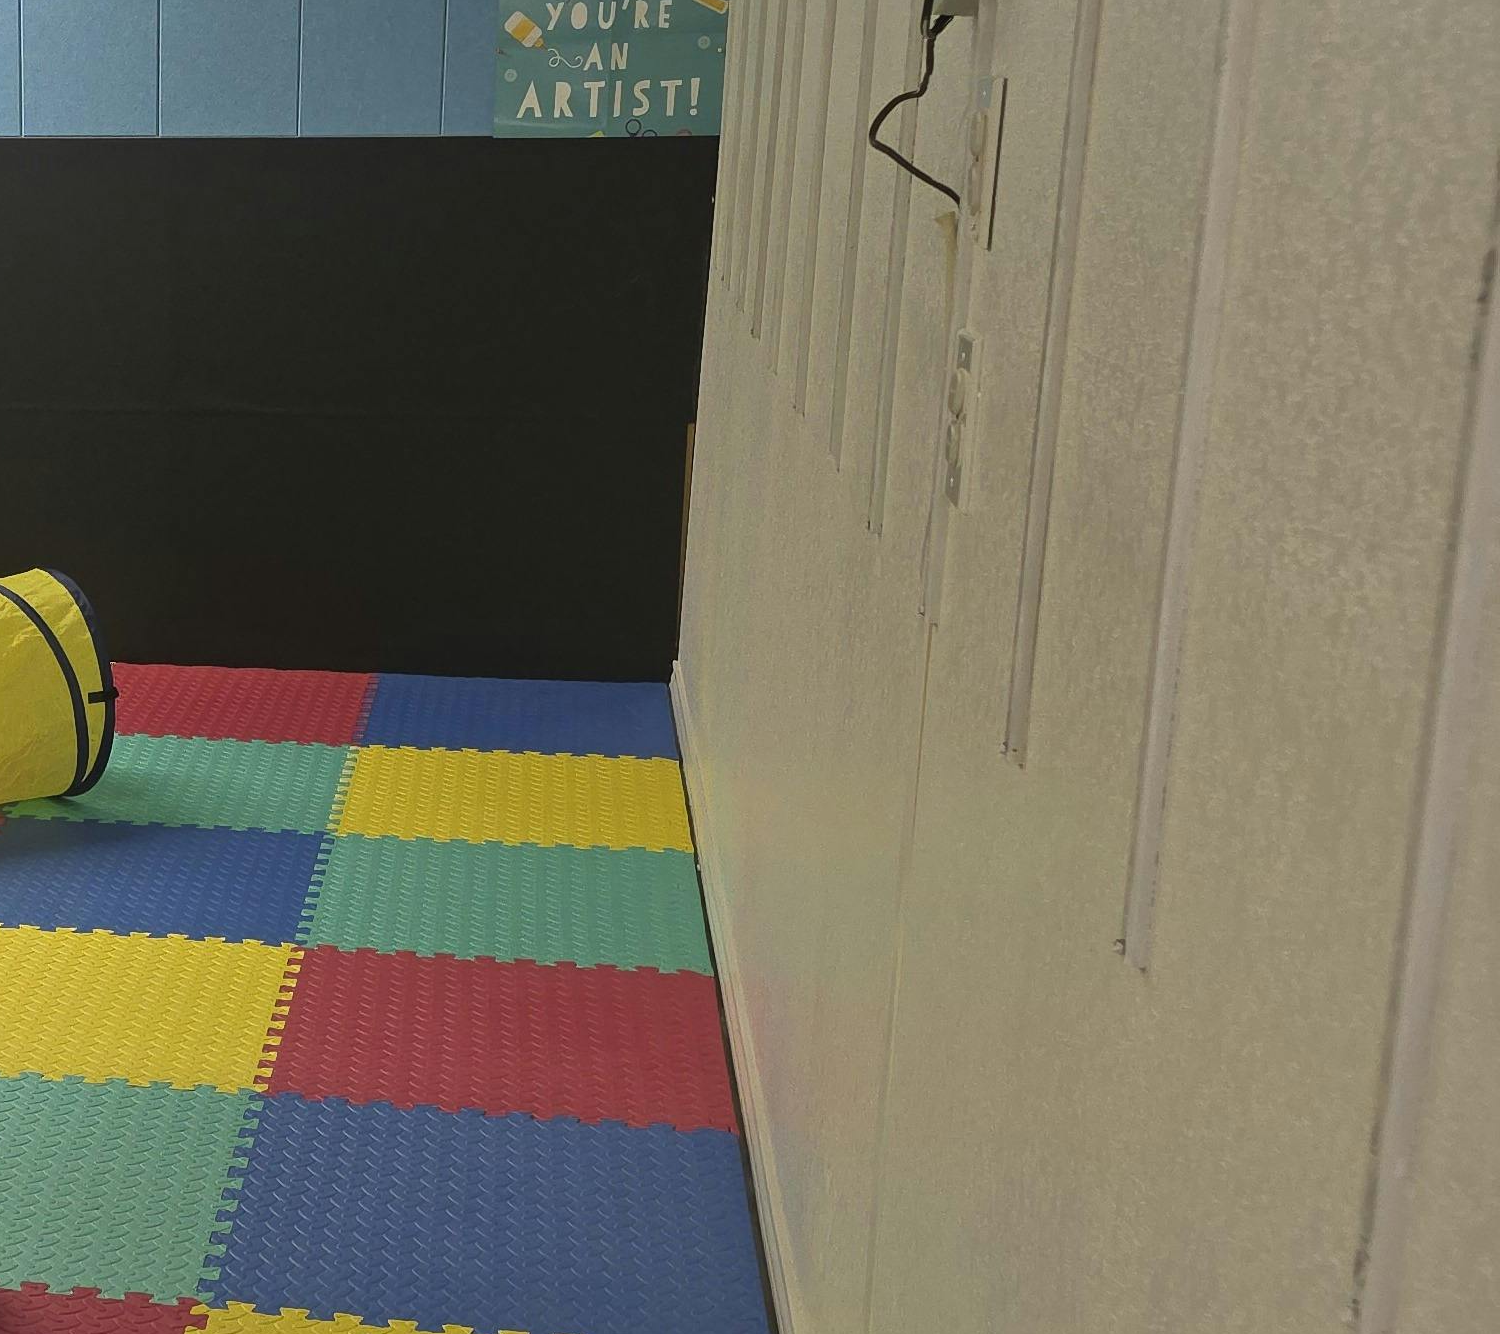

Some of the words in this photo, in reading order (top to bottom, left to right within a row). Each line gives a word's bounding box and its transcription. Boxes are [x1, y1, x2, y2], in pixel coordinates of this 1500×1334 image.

[546, 0, 673, 31] YOU'RE
[583, 43, 629, 71] AN
[516, 78, 700, 118] ARTIST!
